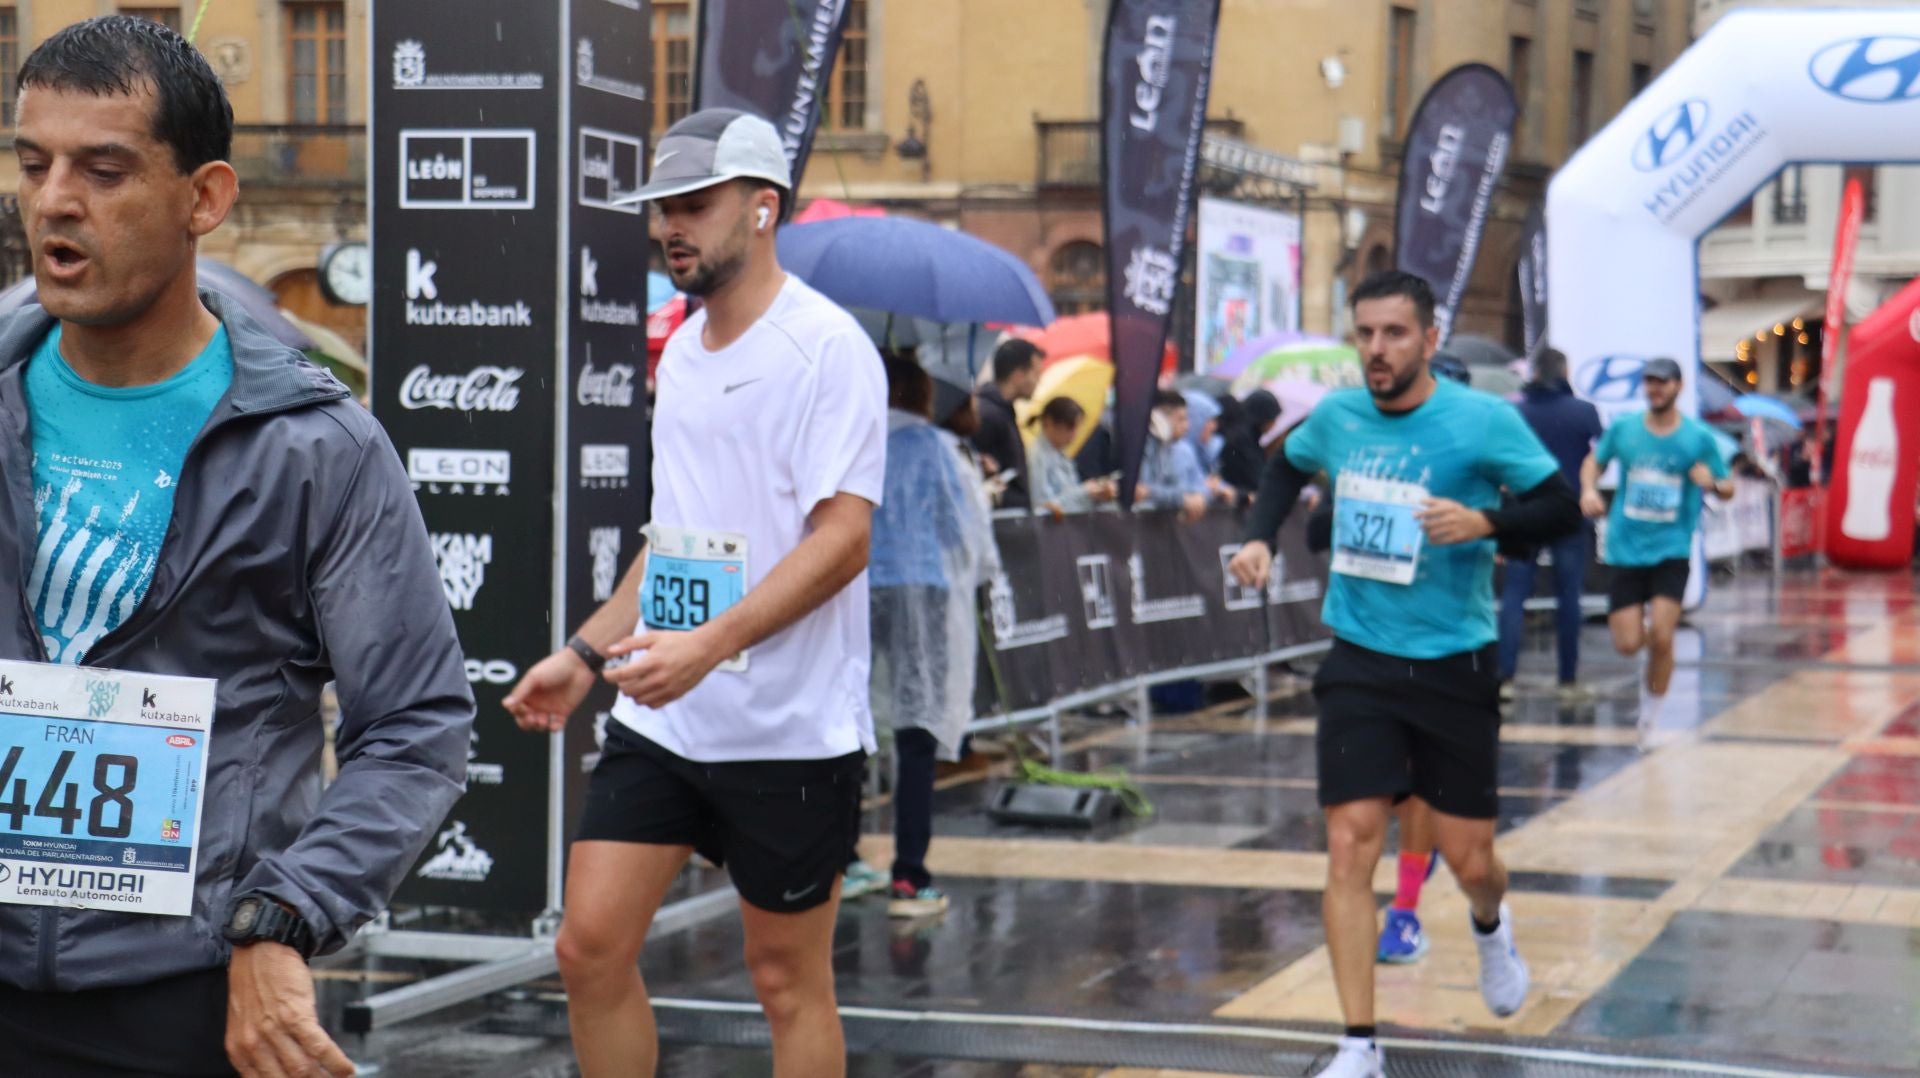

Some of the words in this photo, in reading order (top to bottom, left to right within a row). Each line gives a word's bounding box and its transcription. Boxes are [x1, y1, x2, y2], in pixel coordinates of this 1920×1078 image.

[408, 153, 462, 179] LEÓN
[1645, 111, 1758, 219] HYUNDAI
[406, 248, 437, 299] k
[580, 246, 598, 296] k
[406, 300, 532, 326] kutxabank
[580, 299, 639, 325] kutxabank
[414, 457, 507, 475] LEON
[411, 482, 510, 495] PLAZA
[1352, 513, 1395, 551] 321
[653, 574, 709, 627] 639
[140, 709, 201, 724] kutxabank
[44, 724, 95, 745] FRAN
[168, 736, 193, 746] ABRIL
[0, 745, 139, 839] 448
[42, 851, 114, 862] PARLAMENTARISMO
[43, 842, 77, 850] HYUNDAI
[18, 866, 145, 893] HYUNDAI
[17, 885, 67, 898] Lemauto
[70, 889, 142, 903] Automoción
